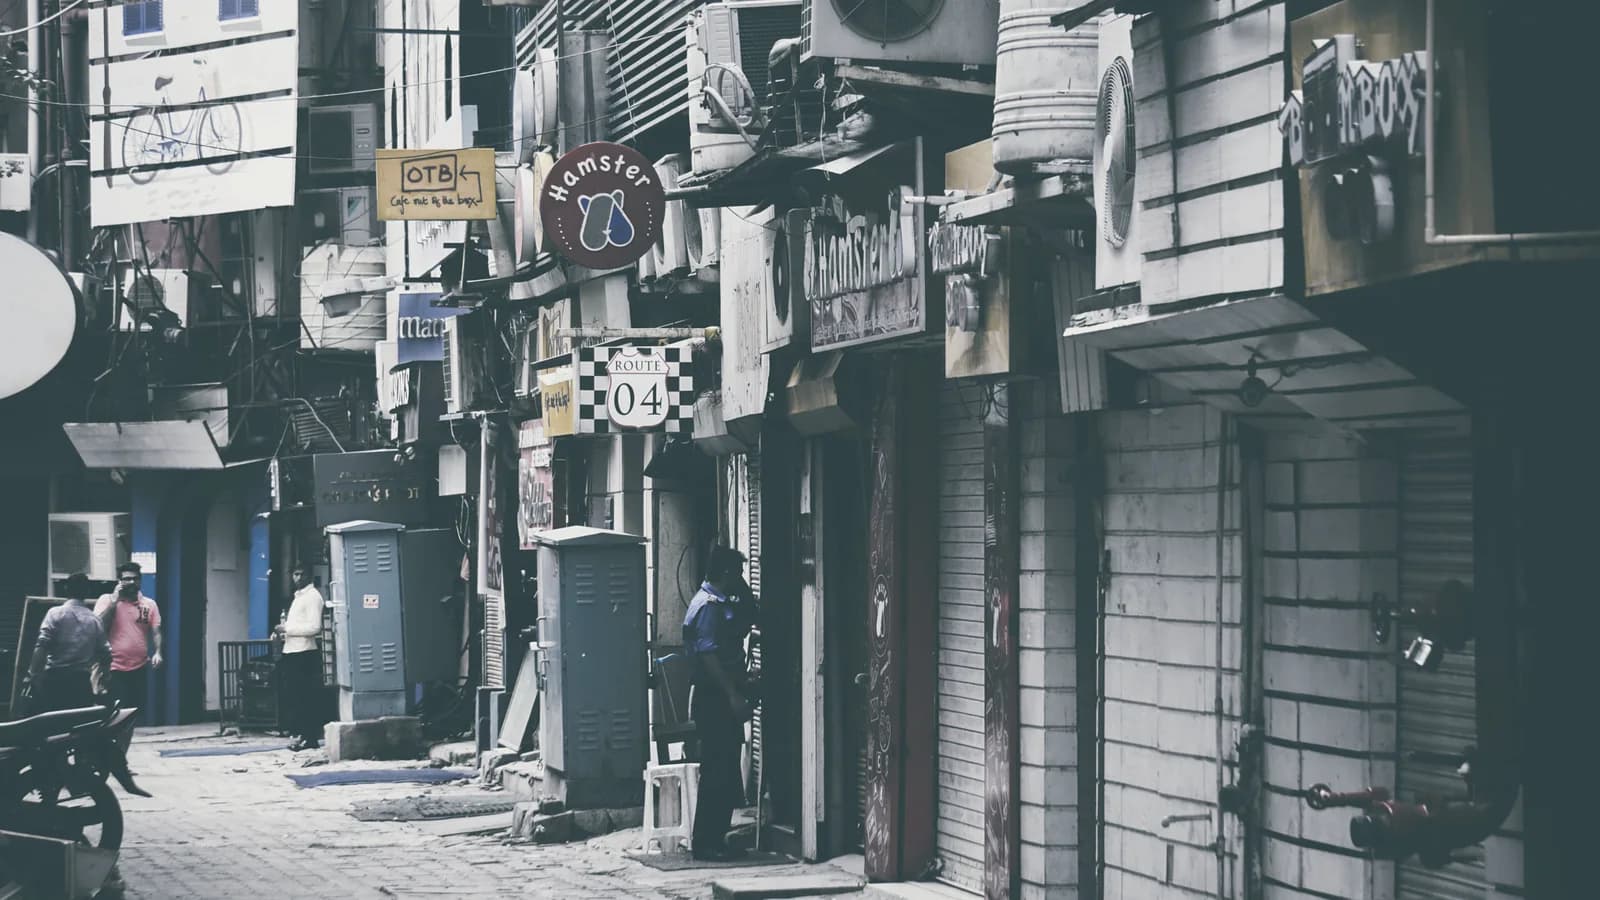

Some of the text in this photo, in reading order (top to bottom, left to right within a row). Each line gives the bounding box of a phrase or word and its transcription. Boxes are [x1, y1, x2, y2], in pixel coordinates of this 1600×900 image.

[1279, 54, 1419, 166] BMBOX
[407, 164, 453, 183] OTB
[548, 154, 651, 202] Hamster
[615, 360, 661, 371] ROUTE
[614, 382, 663, 416] 04
